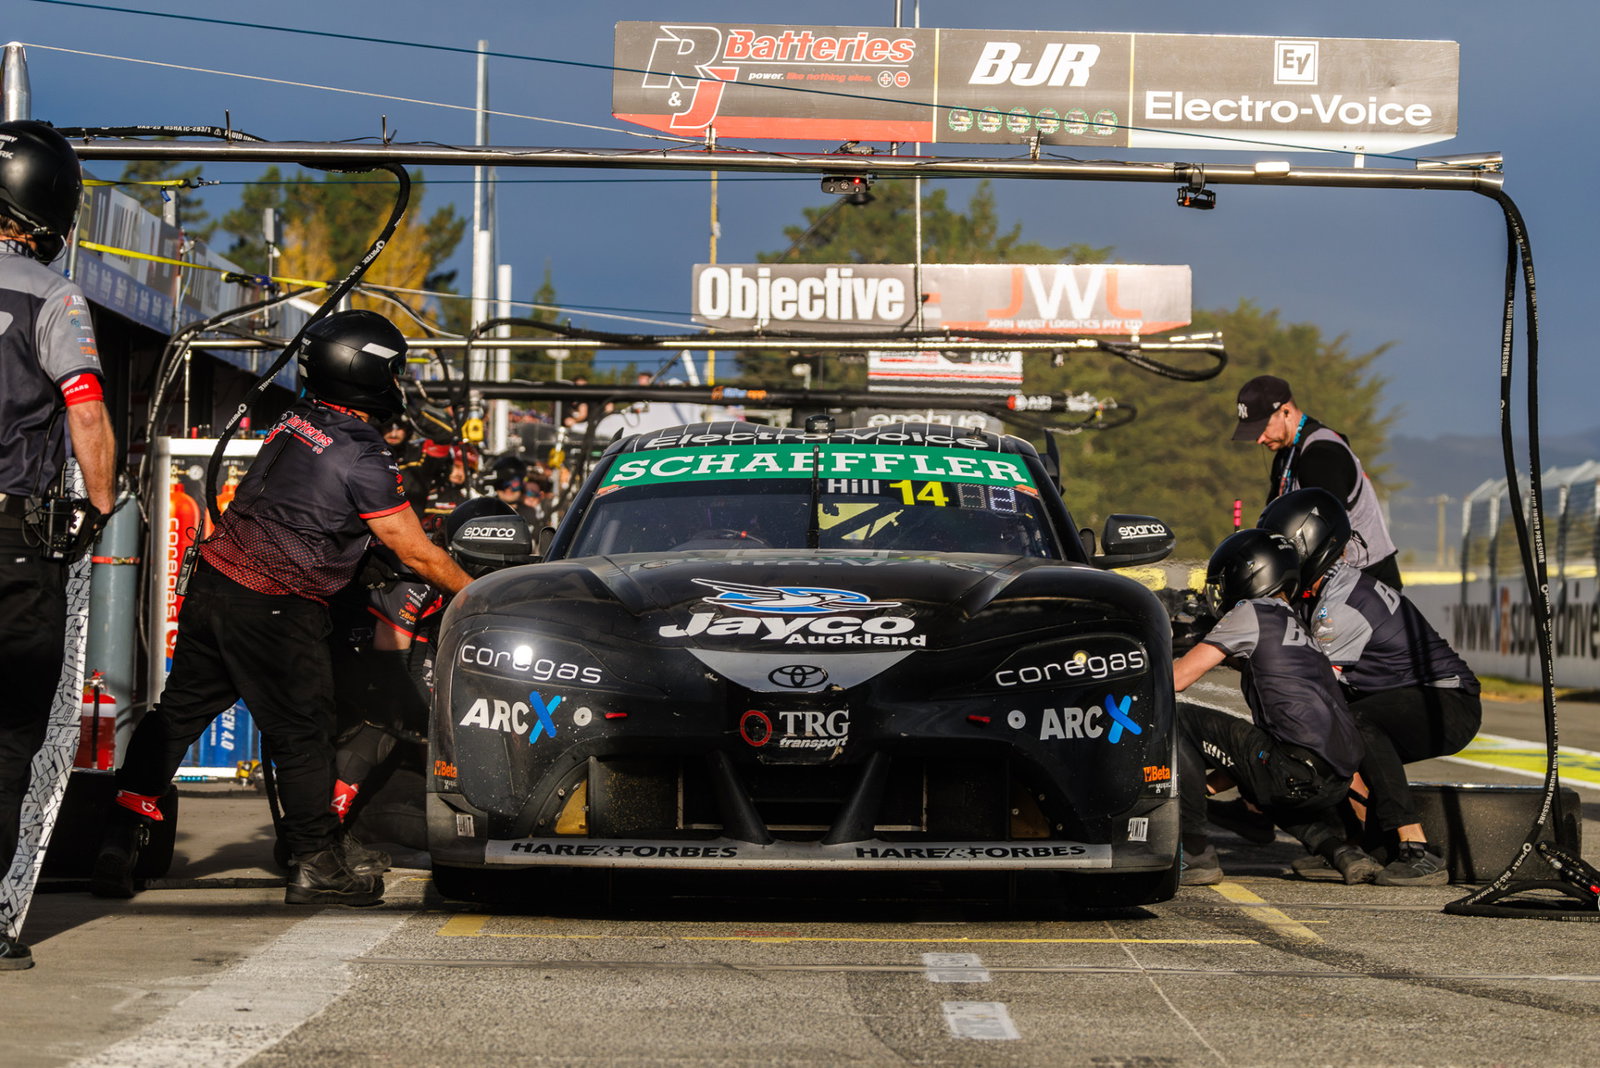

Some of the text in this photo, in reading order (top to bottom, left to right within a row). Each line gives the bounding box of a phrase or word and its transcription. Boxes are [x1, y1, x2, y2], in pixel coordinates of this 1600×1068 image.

[722, 29, 915, 62] Batteries
[968, 42, 1101, 87] BJR
[1282, 49, 1311, 75] EV
[1145, 91, 1432, 127] Electro-Voice
[699, 266, 905, 325] Objective
[986, 265, 1142, 320] JWL
[643, 431, 989, 449] Electro-Voice
[611, 452, 1027, 483] SCHAEFFLER
[827, 478, 880, 495] Hill
[889, 480, 950, 507] 14
[464, 526, 516, 540] sparco
[1118, 524, 1165, 539] sparco
[659, 611, 915, 640] Jayco
[785, 633, 927, 647] Auckland
[460, 644, 603, 685] coregas
[994, 650, 1145, 687] coregas
[778, 709, 851, 737] TRG
[779, 735, 849, 751] transport
